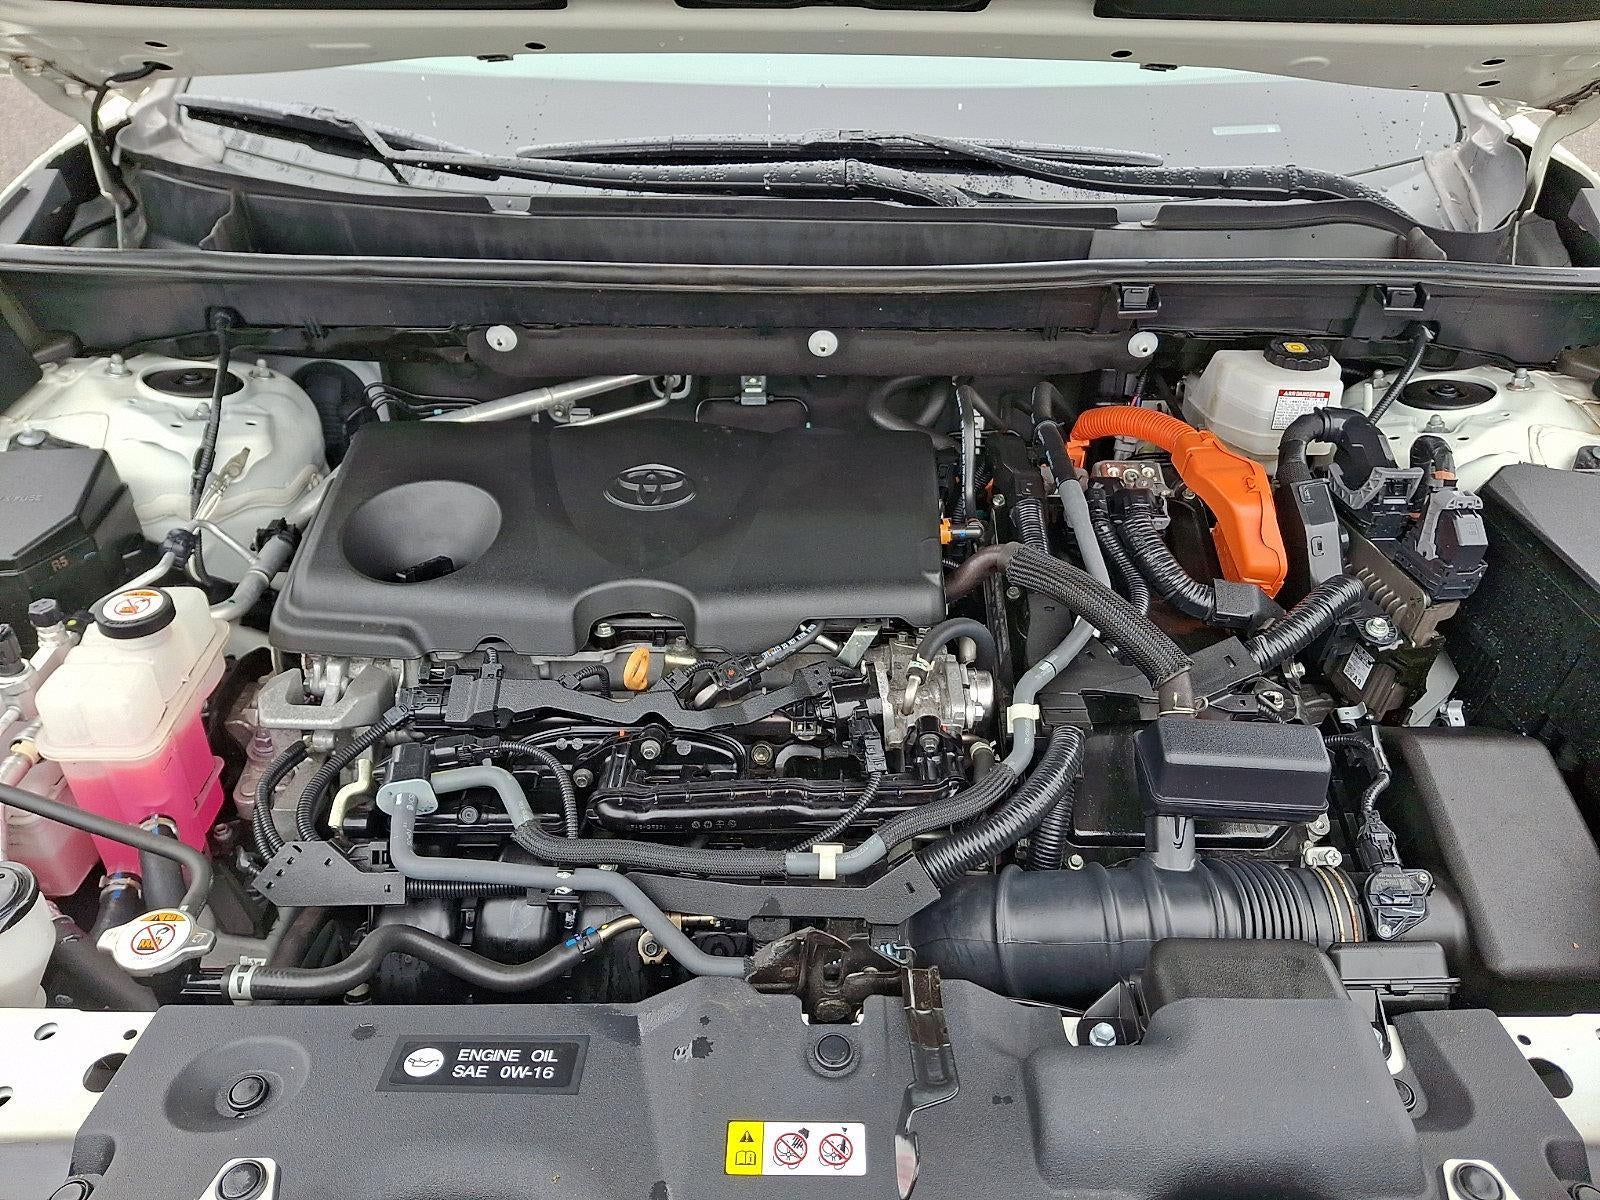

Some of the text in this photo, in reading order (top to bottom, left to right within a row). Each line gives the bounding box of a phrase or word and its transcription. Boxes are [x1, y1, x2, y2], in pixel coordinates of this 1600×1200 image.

[457, 1049, 558, 1062] ENGINE OIL
[452, 1065, 554, 1079] SAE 0W-16
